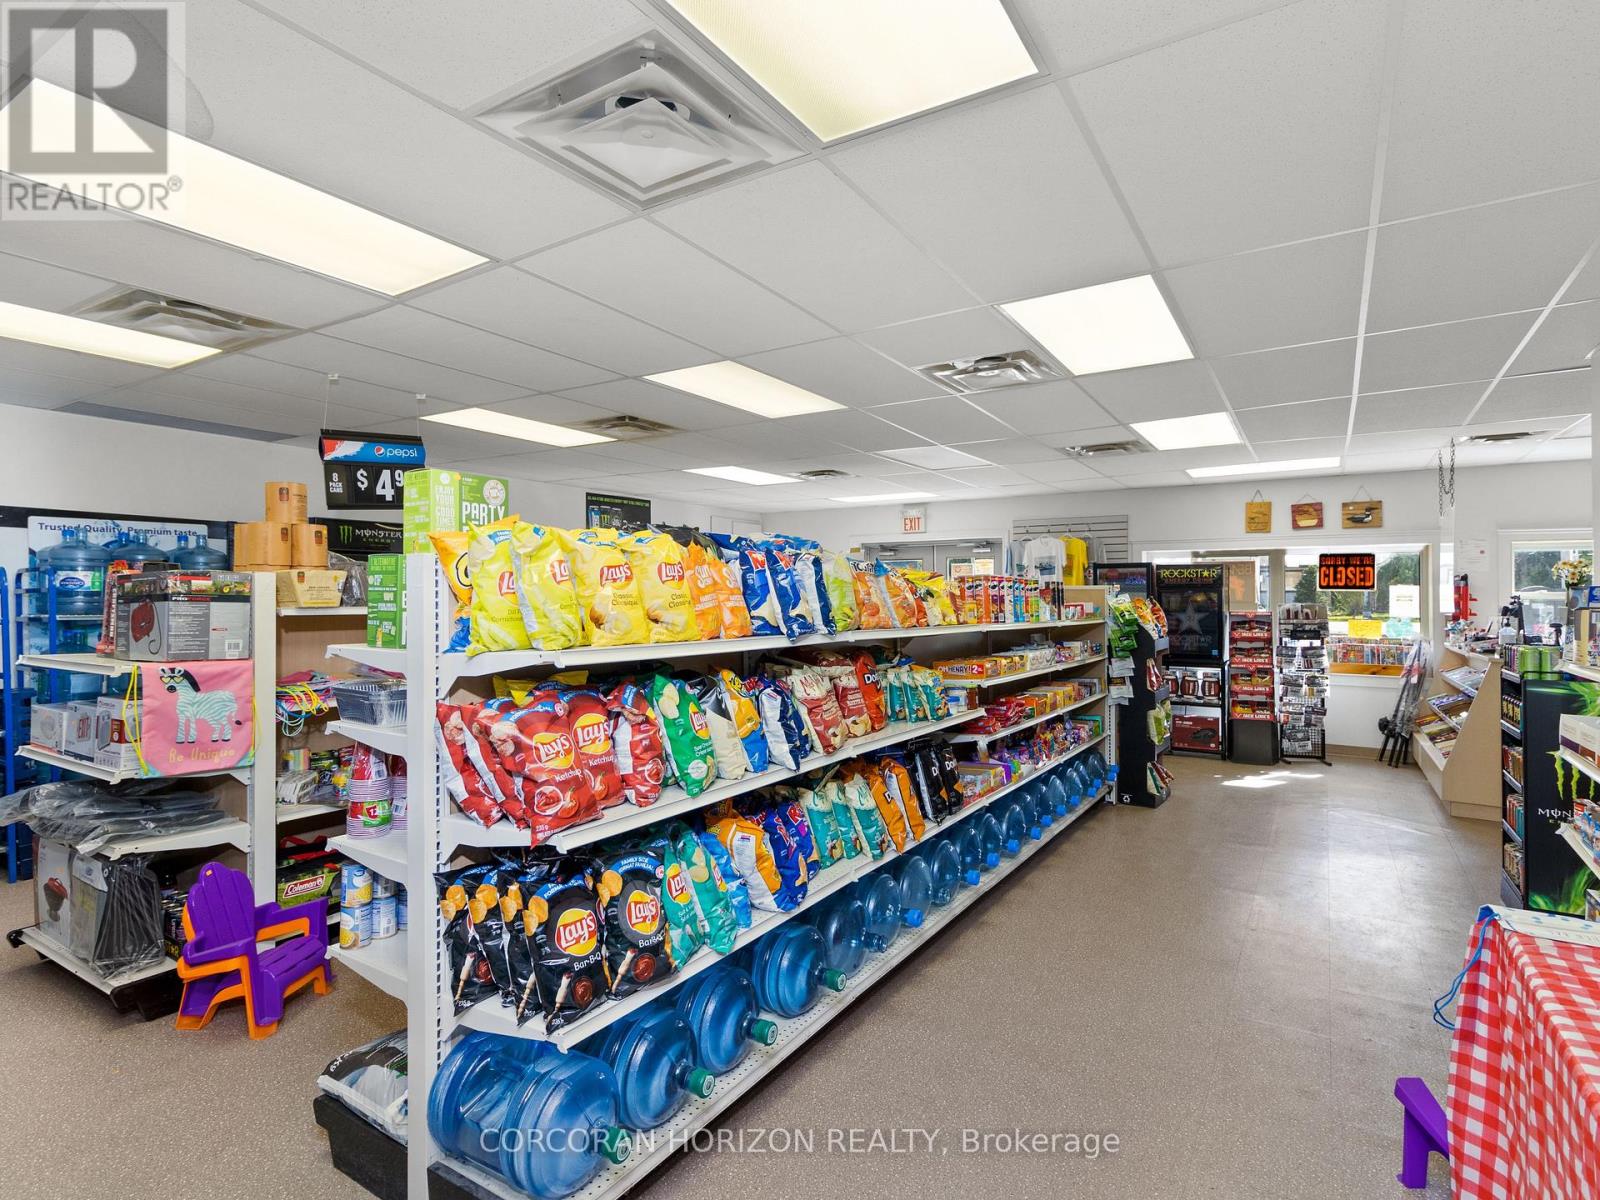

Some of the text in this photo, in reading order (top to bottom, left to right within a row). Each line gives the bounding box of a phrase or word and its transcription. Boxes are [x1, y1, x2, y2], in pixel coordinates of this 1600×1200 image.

[386, 447, 418, 458] pepsi
[332, 472, 339, 482] 8
[356, 468, 369, 491] $
[462, 501, 506, 525] PARTY
[355, 528, 403, 539] MONSTER
[903, 517, 922, 532] EXIT
[600, 563, 632, 586] Lay's
[660, 562, 684, 584] Lay's
[1320, 567, 1374, 587] CLOSED
[577, 718, 611, 748] Lay's
[168, 748, 236, 764] Be Unique
[538, 734, 571, 763] Lay's
[554, 769, 583, 783] Ketchup
[287, 881, 317, 895] Coleman
[630, 900, 661, 924] Lay's
[560, 912, 597, 950] Lay's
